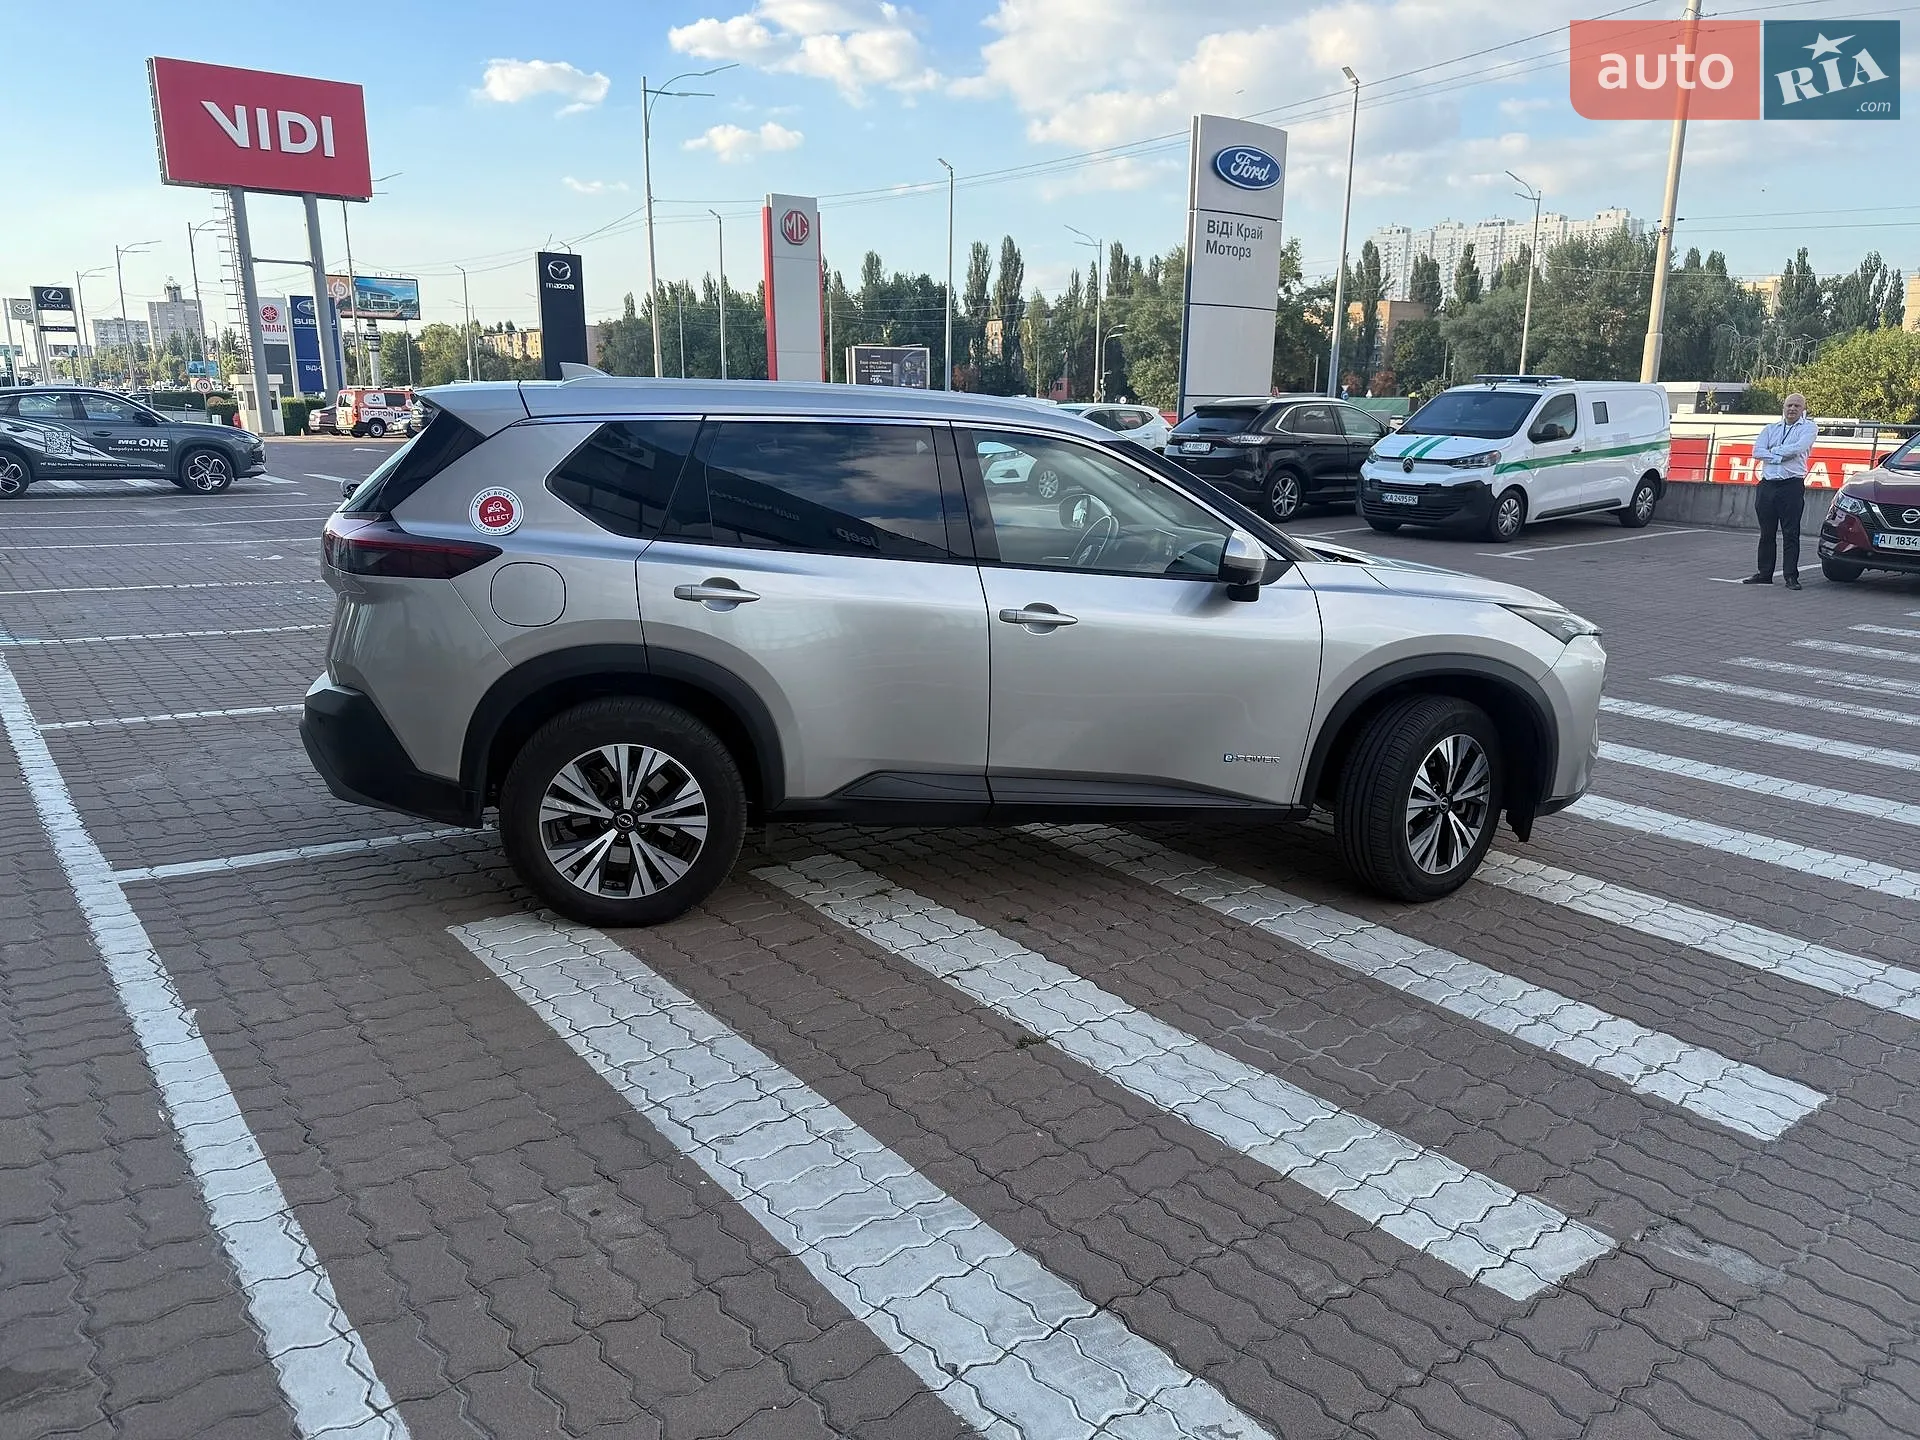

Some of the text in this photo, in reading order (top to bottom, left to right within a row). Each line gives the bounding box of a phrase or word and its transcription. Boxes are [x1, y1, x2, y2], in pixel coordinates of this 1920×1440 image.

[200, 100, 336, 158] VIDI
[1230, 152, 1271, 182] Ford
[784, 213, 808, 240] MG
[1207, 220, 1263, 241] ВіДі Край
[1205, 240, 1252, 260] Моторз
[139, 438, 169, 447] ONE
[484, 514, 510, 522] SELECT
[1896, 536, 1918, 546] 1834
